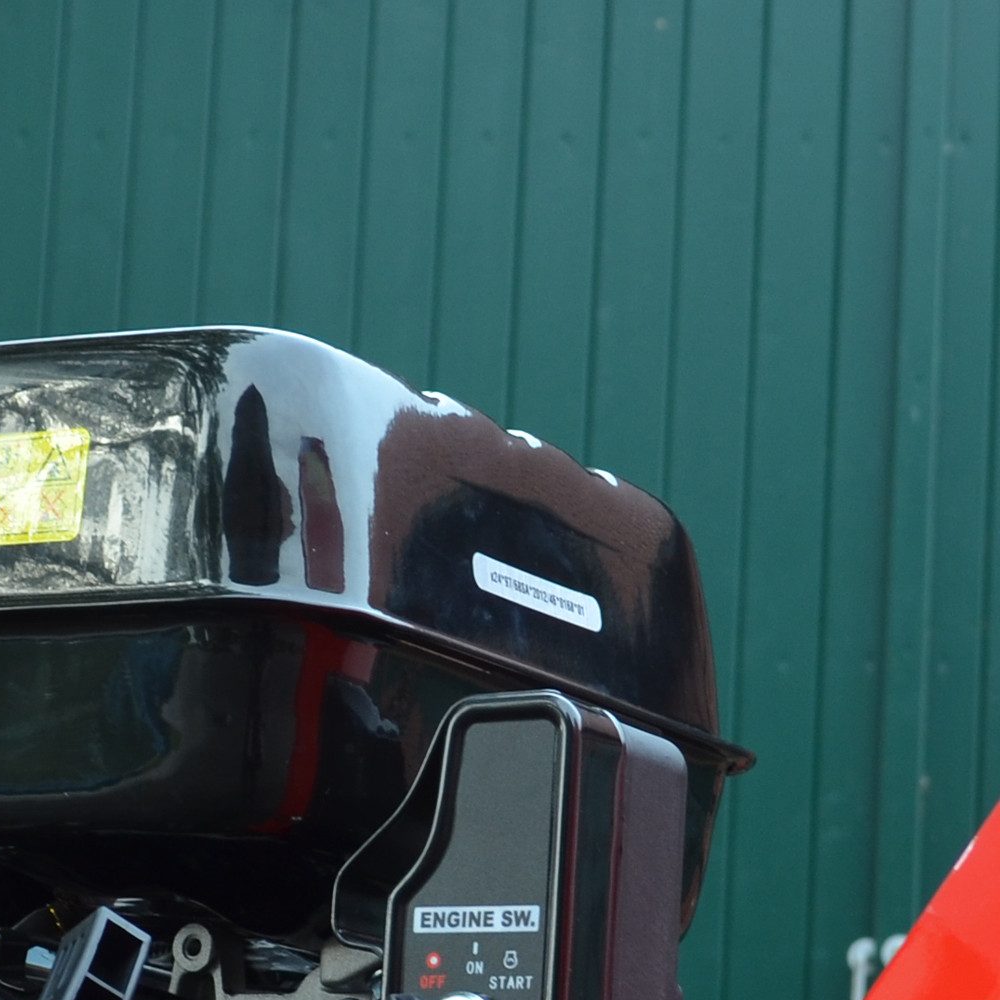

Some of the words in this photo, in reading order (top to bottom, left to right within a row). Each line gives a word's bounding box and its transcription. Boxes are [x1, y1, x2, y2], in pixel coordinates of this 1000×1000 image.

[420, 911, 494, 928] ENGINE
[501, 910, 535, 927] SW.
[466, 961, 484, 974] ON
[420, 975, 446, 989] OFF
[489, 976, 533, 990] START
